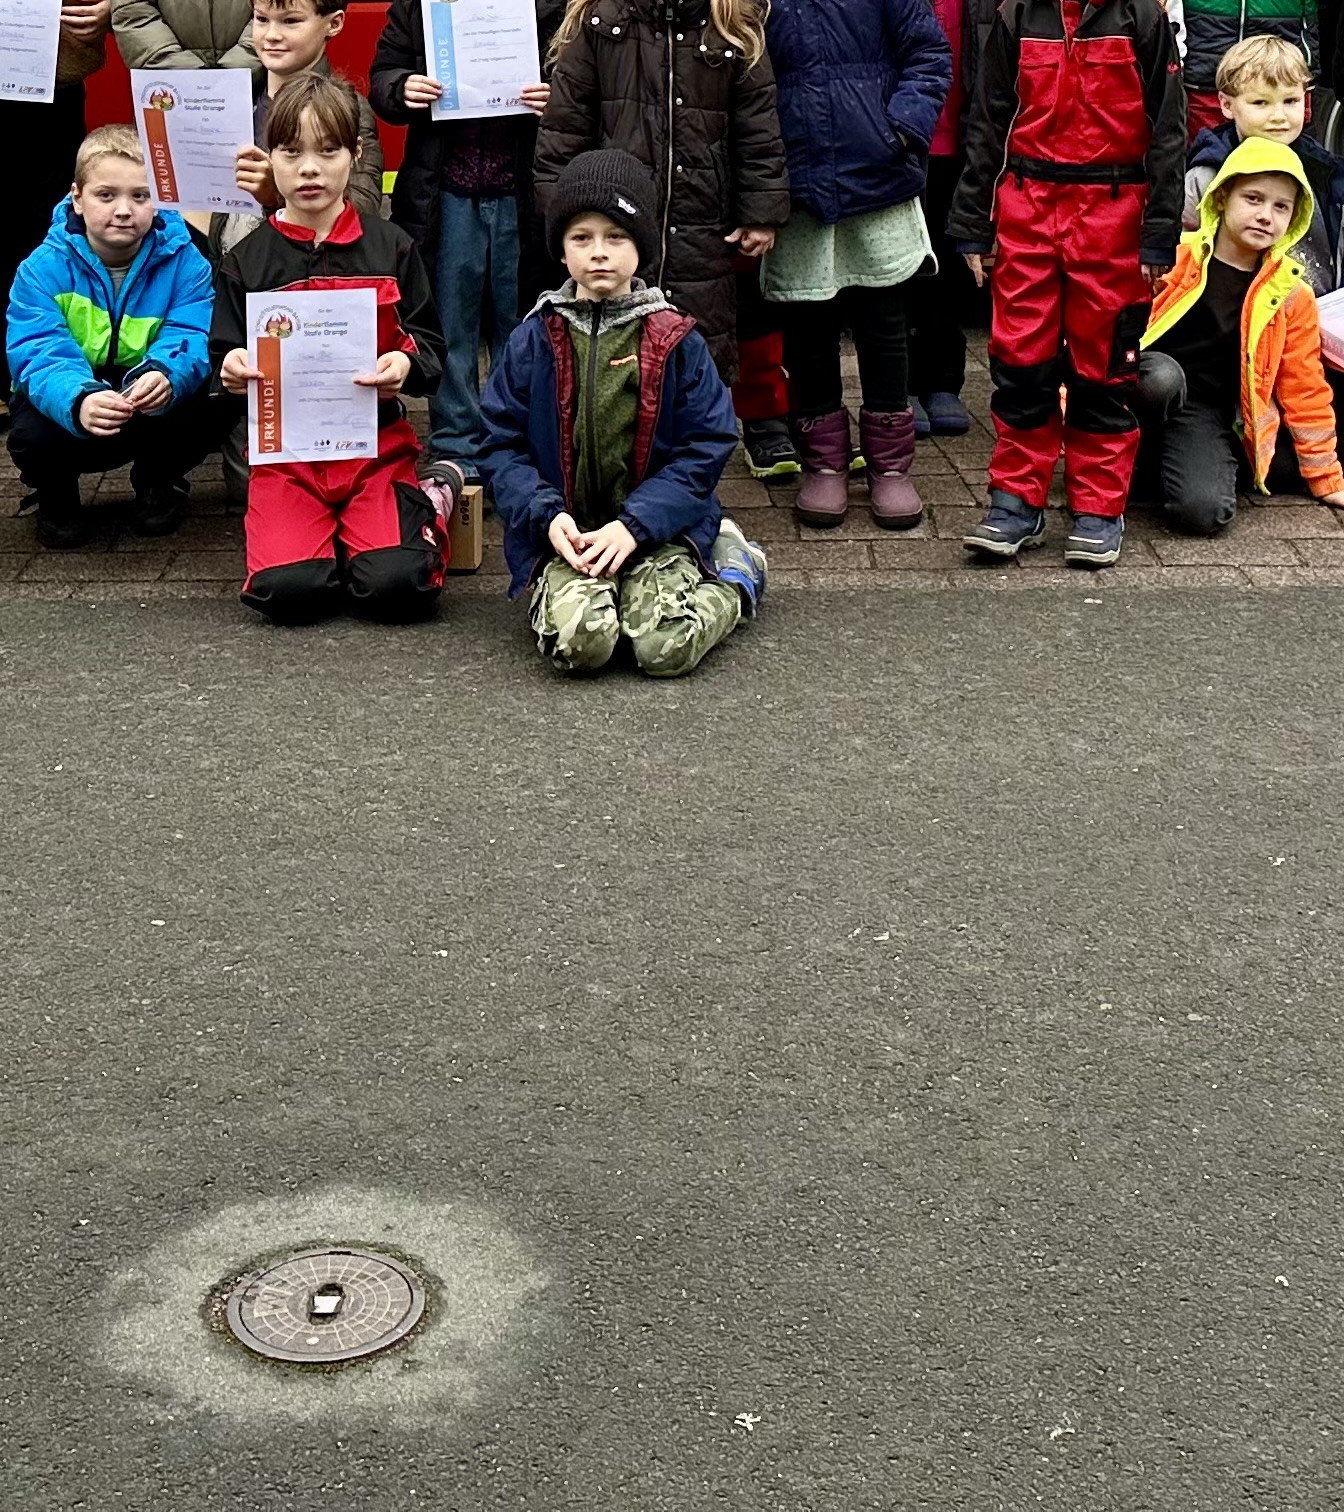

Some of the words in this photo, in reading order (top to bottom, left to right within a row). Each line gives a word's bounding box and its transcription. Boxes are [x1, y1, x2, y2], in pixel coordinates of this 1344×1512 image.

[438, 38, 453, 110] URKUNDE
[153, 142, 174, 202] URKUNDE
[263, 379, 276, 453] URKUNDE
